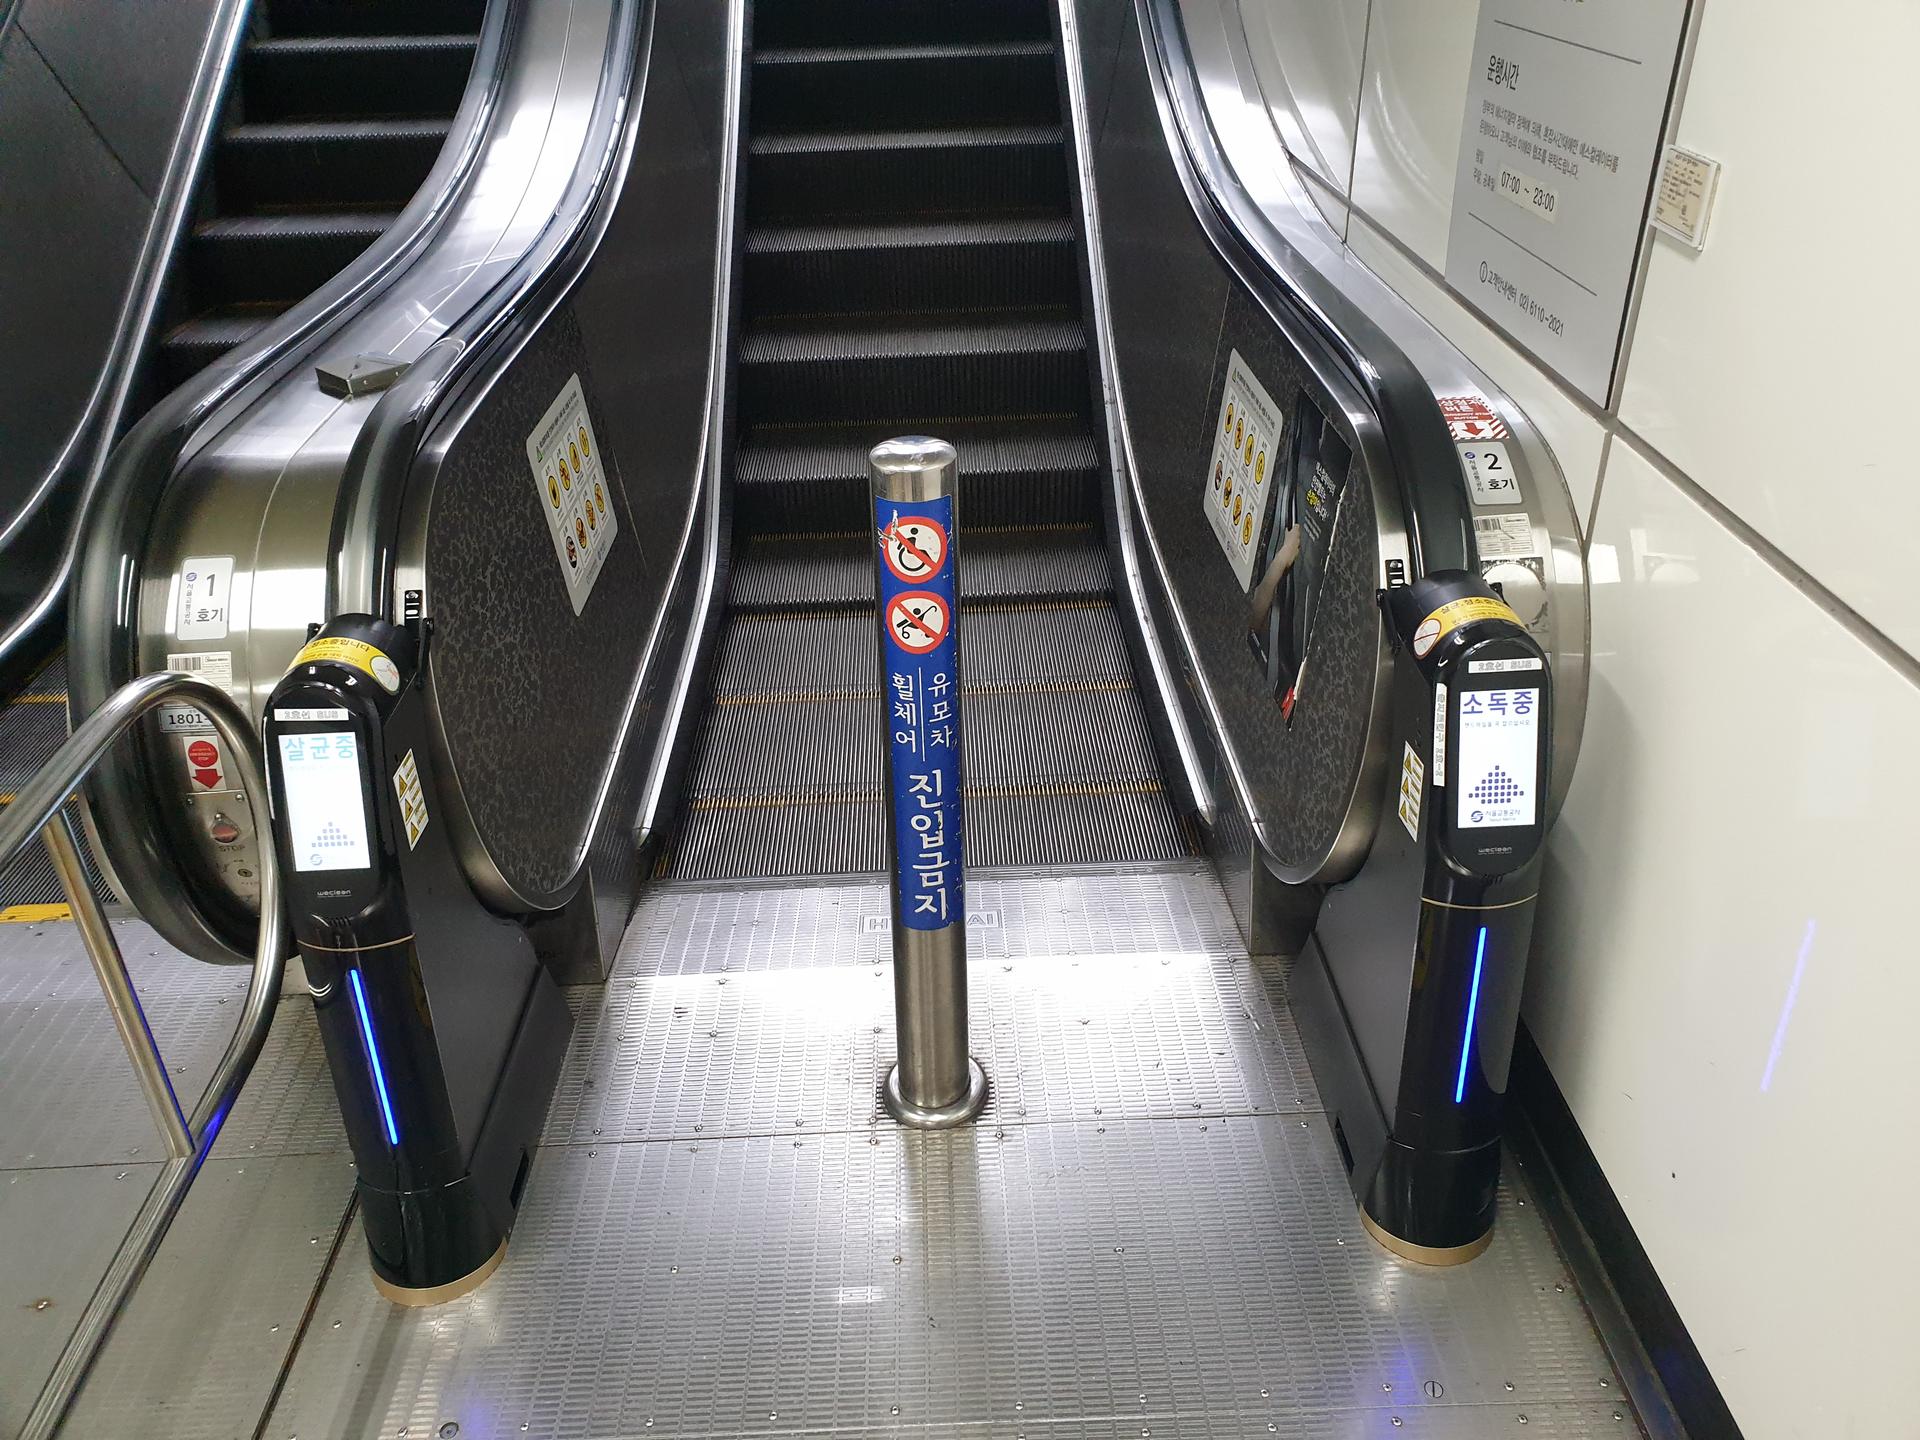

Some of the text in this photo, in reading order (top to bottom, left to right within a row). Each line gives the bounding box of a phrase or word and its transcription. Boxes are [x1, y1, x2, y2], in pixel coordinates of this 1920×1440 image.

[1487, 54, 1520, 91] 운행시간
[1501, 170, 1520, 195] 07:00
[1533, 187, 1555, 213] 23:00
[1519, 292, 1529, 315] 02)
[1529, 299, 1565, 338] 6110-2021
[1484, 453, 1502, 470] 2
[1488, 478, 1515, 490] 호기
[206, 573, 216, 597] 1
[196, 607, 224, 622] 호기
[891, 671, 918, 755] 휠체어
[927, 671, 954, 750] 유모차
[1462, 690, 1533, 717] 소독중
[284, 735, 355, 762] 살균중
[908, 770, 949, 922] 진입금지
